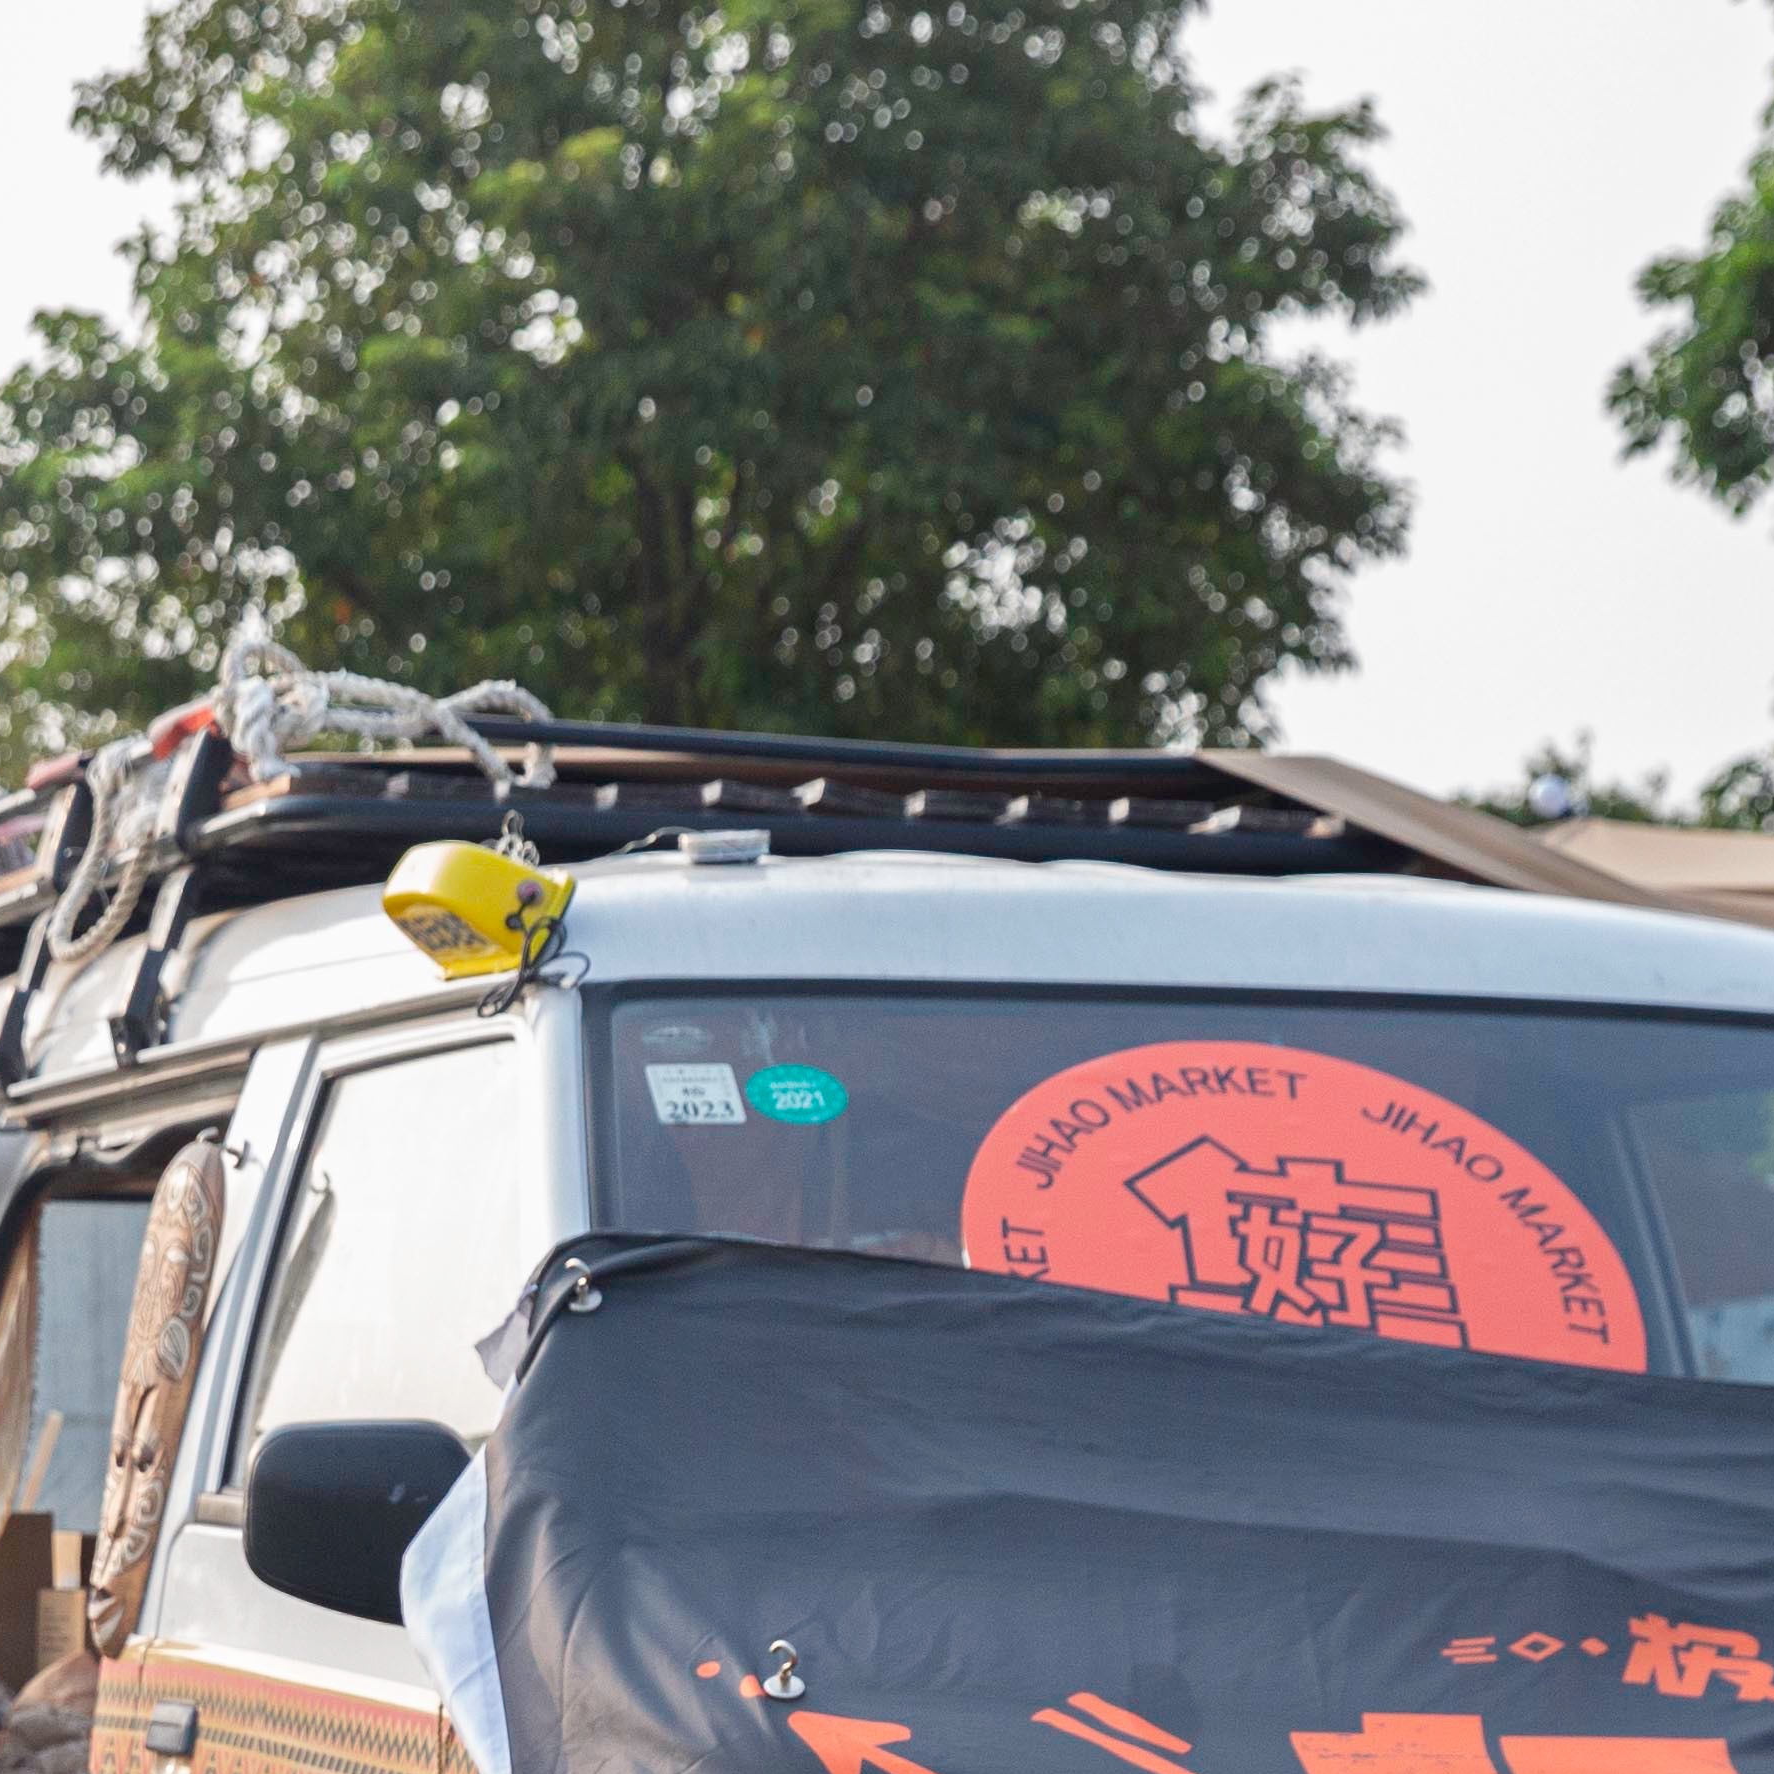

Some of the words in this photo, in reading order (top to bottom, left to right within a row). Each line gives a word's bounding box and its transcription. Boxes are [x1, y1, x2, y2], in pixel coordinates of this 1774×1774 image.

[1016, 1099, 1111, 1190] JIHAO
[1105, 1066, 1308, 1113] MARKET
[1360, 1101, 1504, 1182] JIHAO
[1498, 1186, 1610, 1345] MARKET
